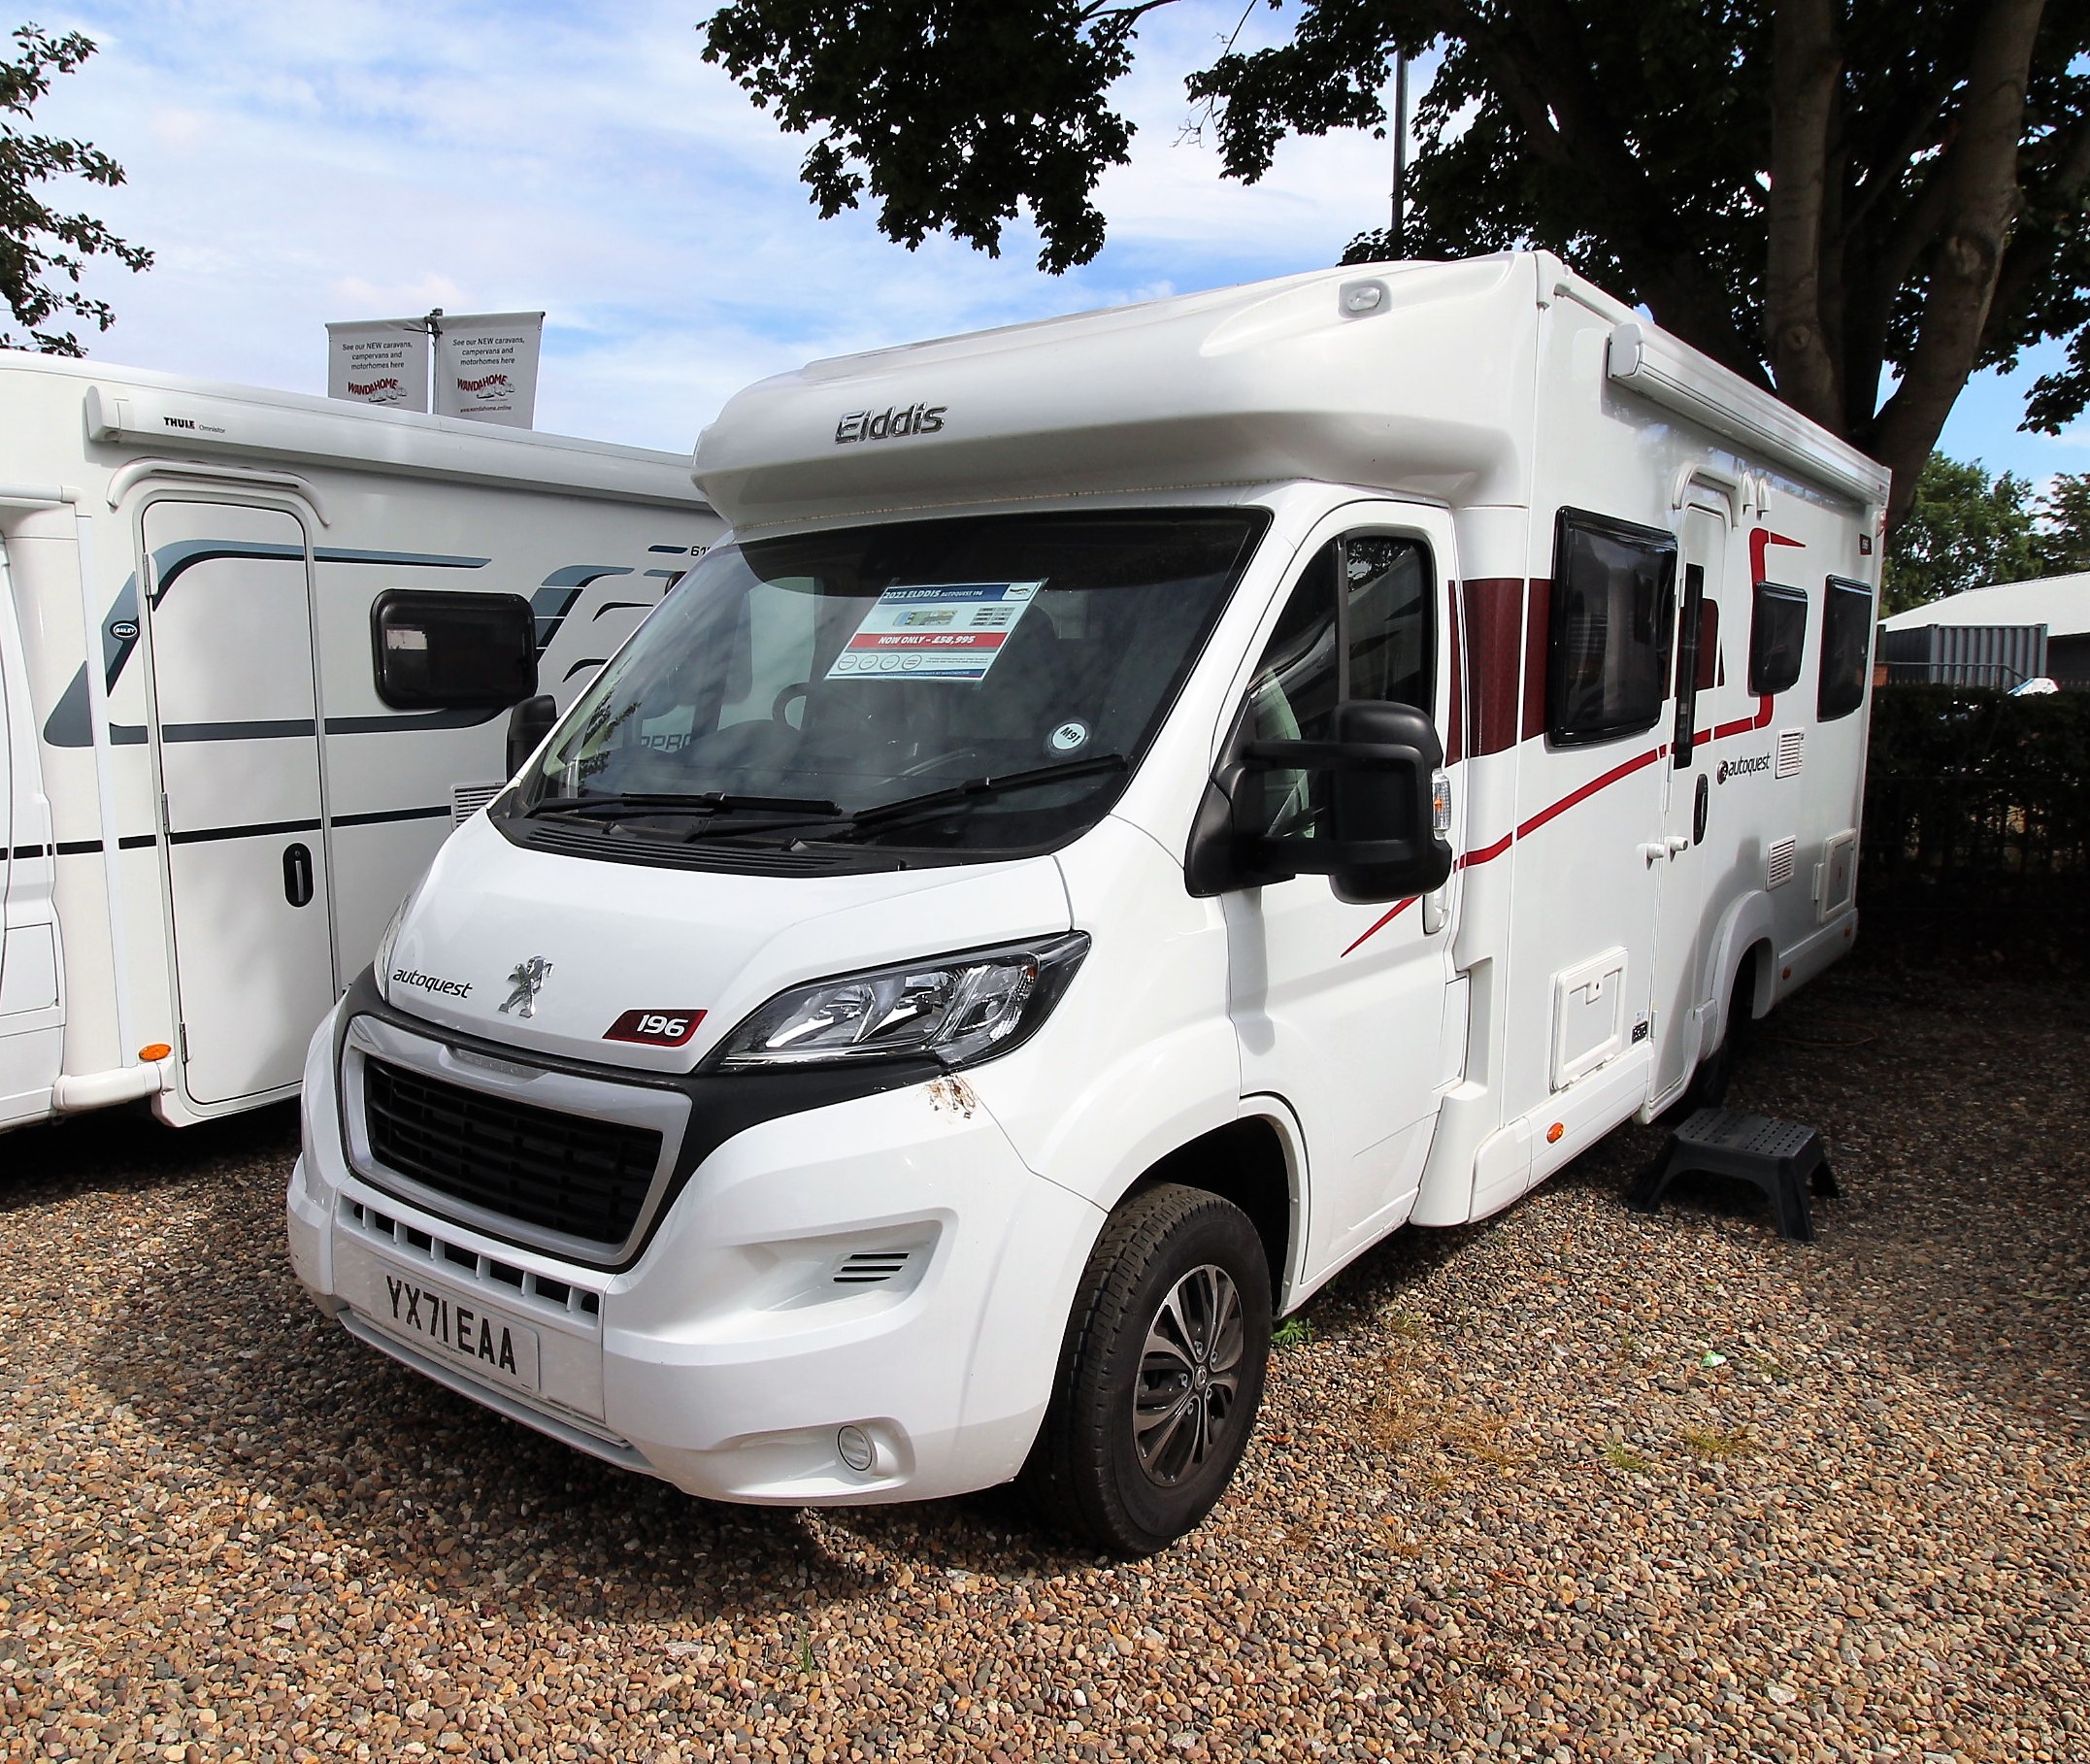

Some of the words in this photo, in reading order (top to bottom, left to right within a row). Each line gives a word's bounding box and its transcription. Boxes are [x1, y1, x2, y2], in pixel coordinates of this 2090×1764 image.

[461, 348, 500, 356] campervans
[348, 378, 398, 395] WANDAHOME
[457, 374, 509, 391] WANDAHOME
[163, 416, 195, 429] THULE
[199, 424, 225, 433] Omnistor
[835, 402, 948, 444] Elddis
[690, 545, 711, 556] 61
[907, 589, 942, 598] ELDDIS
[878, 636, 902, 645] NOW
[1060, 726, 1081, 743] M91
[1728, 751, 1772, 777] autoquest
[392, 969, 473, 999] autoquest
[637, 1014, 689, 1038] 196
